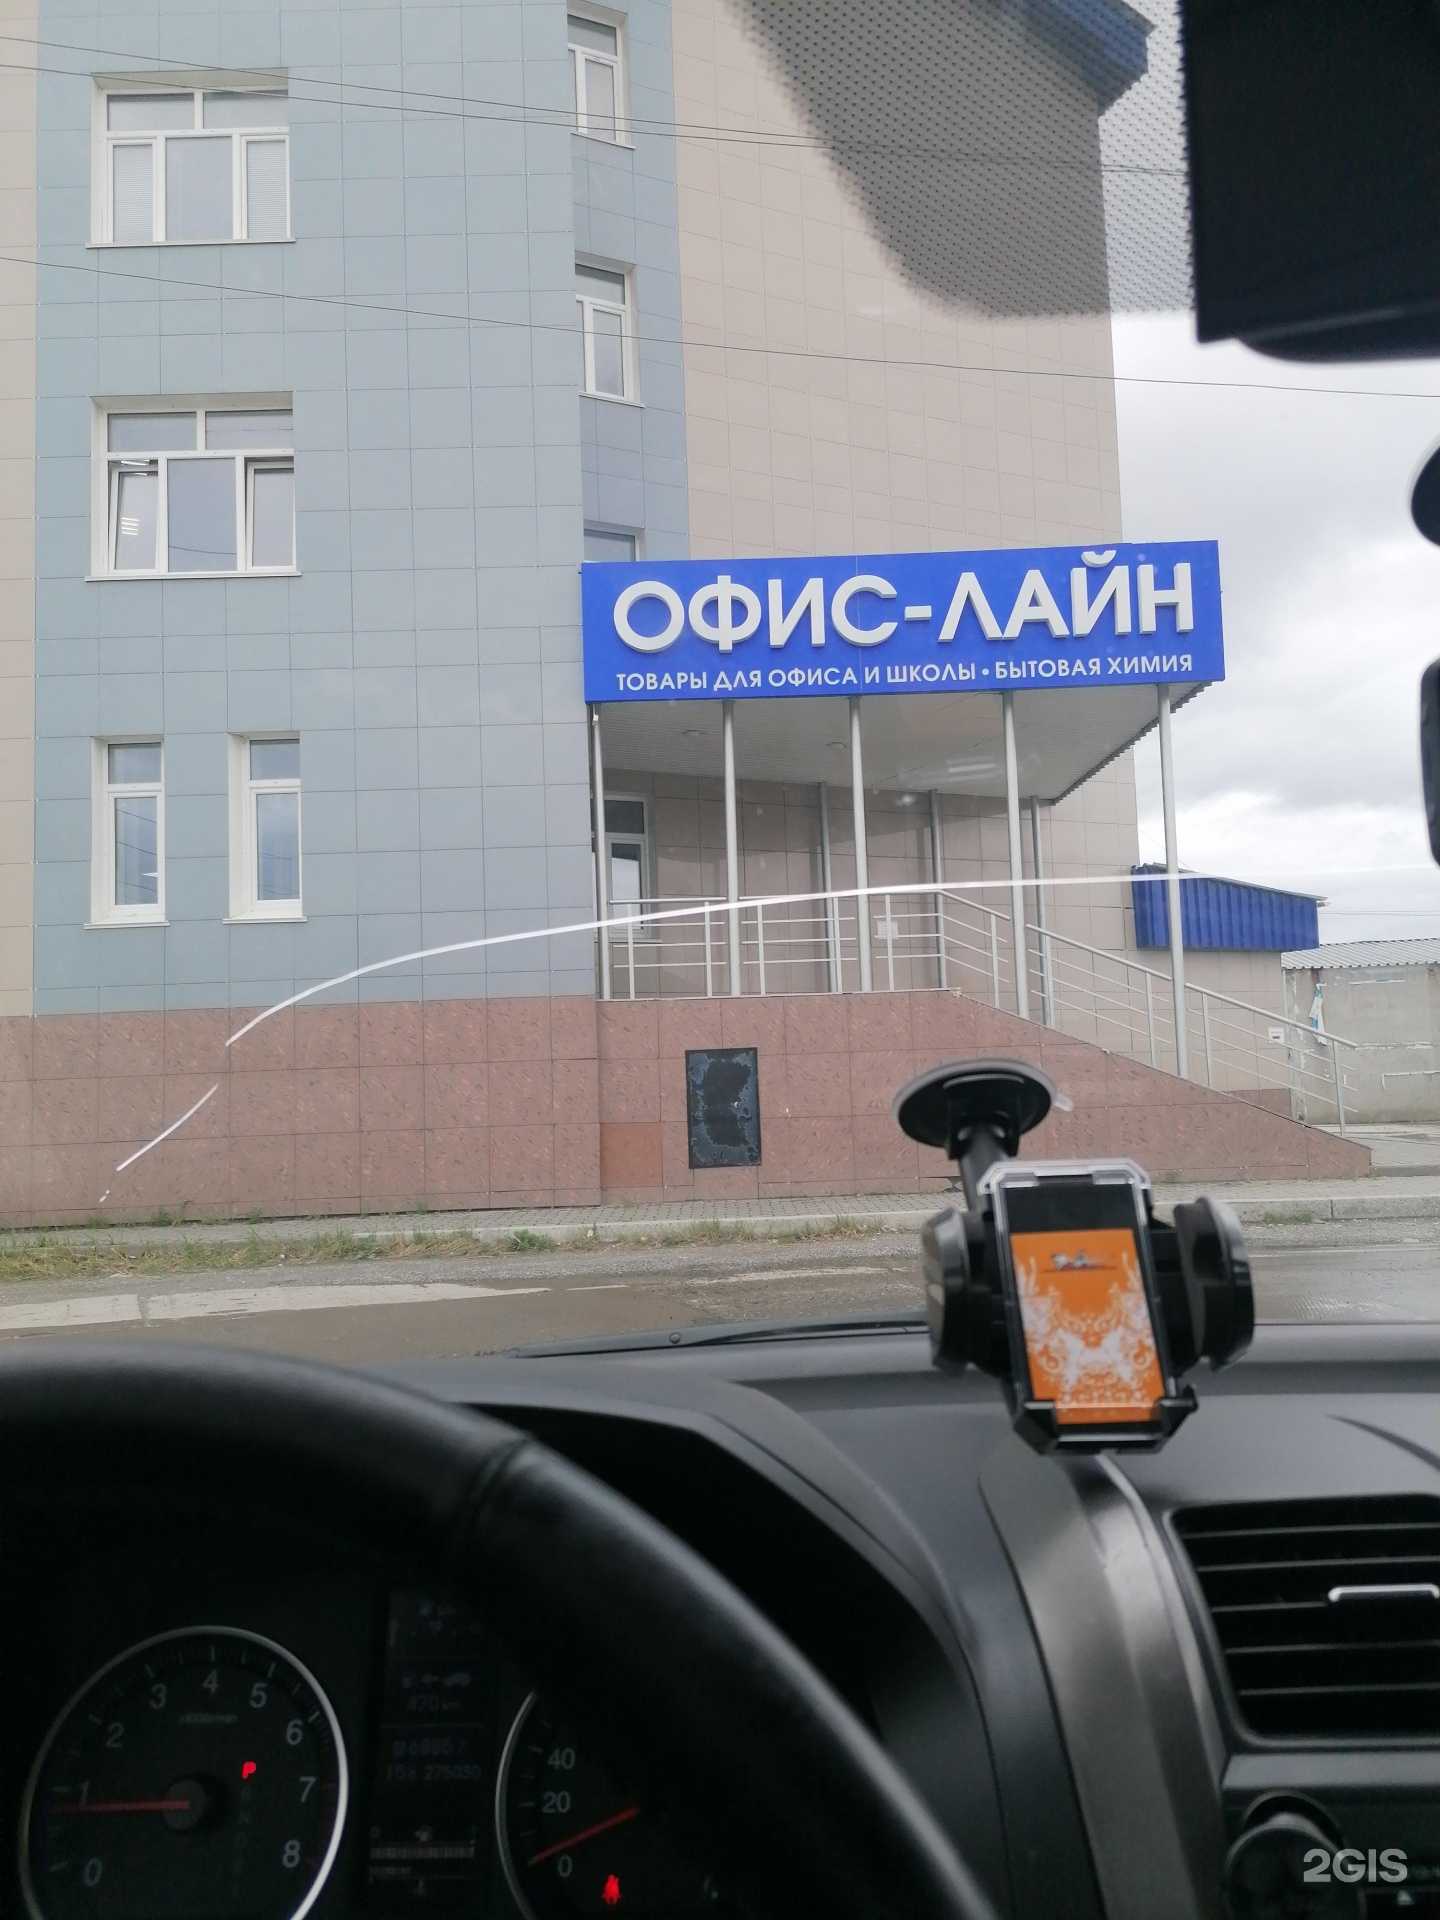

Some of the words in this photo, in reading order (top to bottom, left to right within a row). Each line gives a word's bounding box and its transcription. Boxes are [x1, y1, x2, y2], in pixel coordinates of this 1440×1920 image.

[613, 549, 1194, 654] ОФИС-ЛАЙН
[616, 671, 707, 691] ТОВАРЫ
[713, 669, 761, 691] ДЛЯ
[768, 666, 858, 687] ОФИСА
[865, 666, 880, 684] И
[887, 663, 975, 683] ШКОЛЫ
[995, 658, 1101, 680] БЫТОВАЯ
[1107, 654, 1193, 675] ХИМИЯ
[202, 1669, 220, 1694] 4
[150, 1683, 168, 1709] 3
[250, 1683, 268, 1709] 5
[105, 1723, 125, 1749] 2
[285, 1719, 303, 1745] 6
[241, 1759, 257, 1780] P
[548, 1748, 576, 1770] 40
[78, 1780, 90, 1806] 1
[299, 1775, 317, 1804] 7
[542, 1791, 571, 1813] 20
[281, 1839, 301, 1868] 8
[557, 1855, 573, 1878] 0
[83, 1857, 103, 1886] 0
